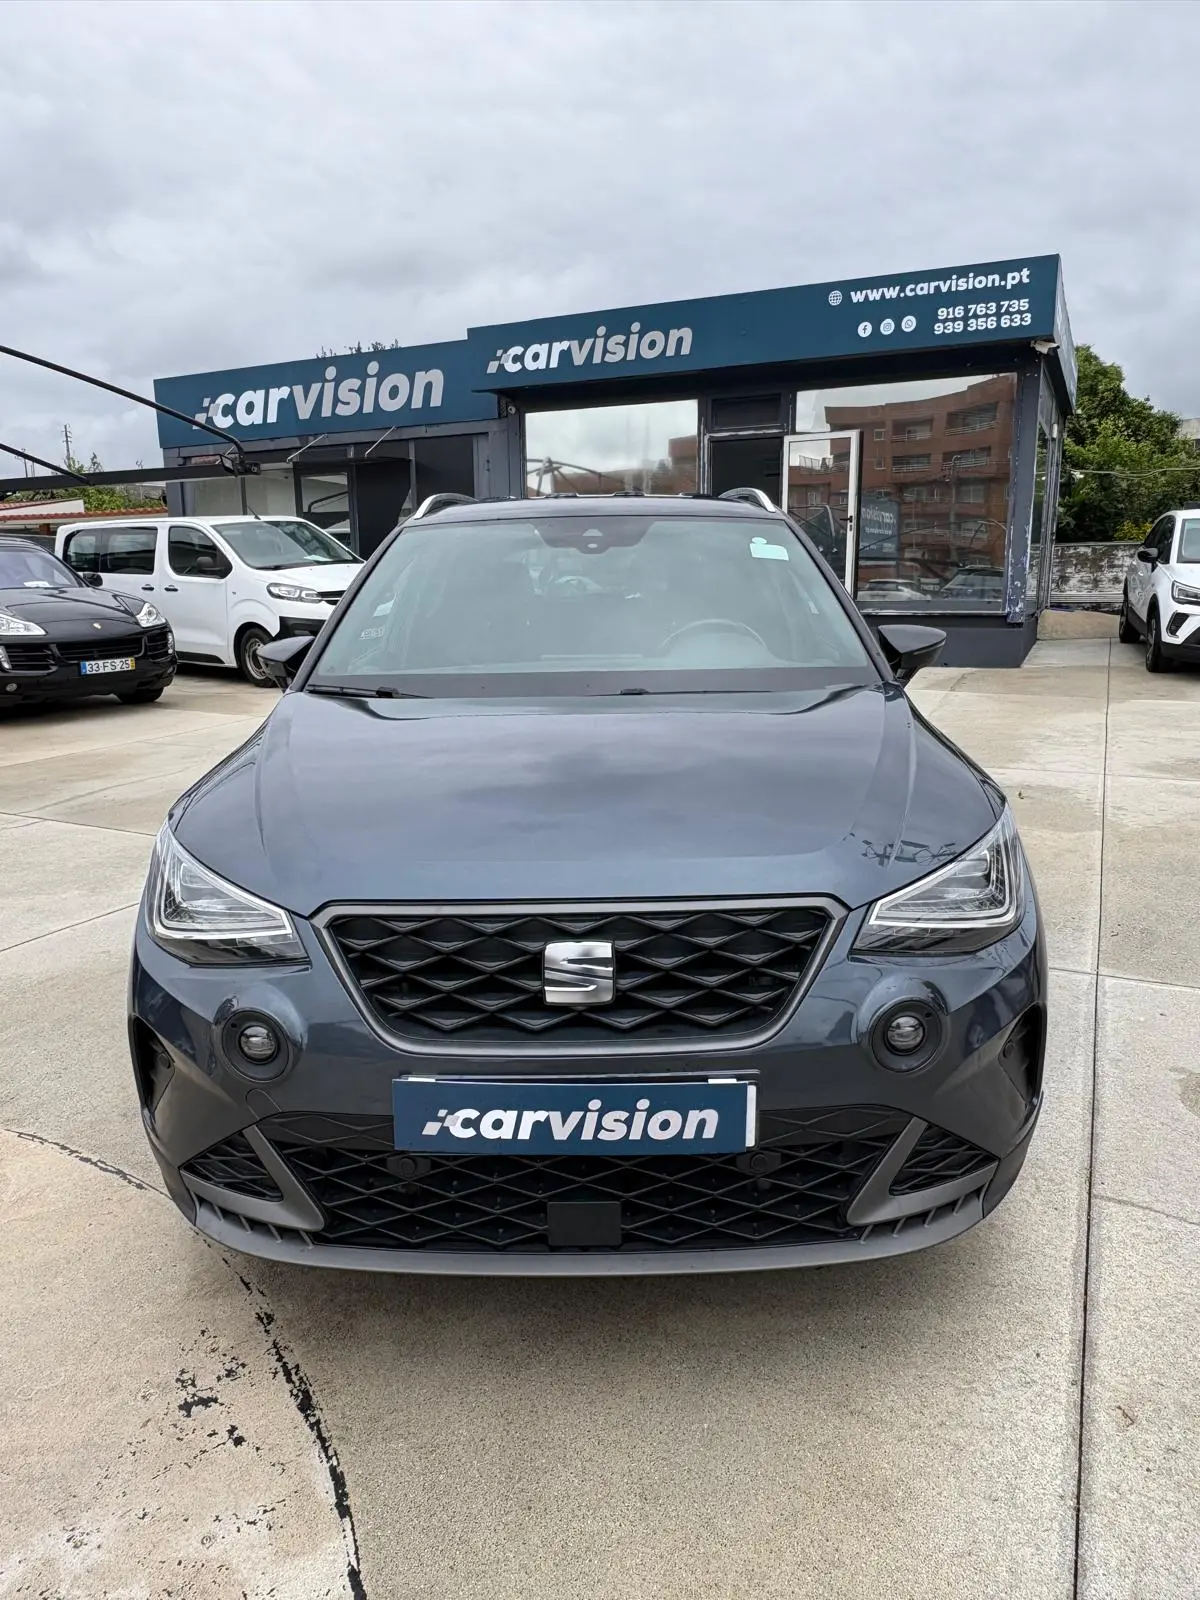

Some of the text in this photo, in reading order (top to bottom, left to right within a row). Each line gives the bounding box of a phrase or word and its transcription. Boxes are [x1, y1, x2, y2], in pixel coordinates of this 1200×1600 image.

[850, 267, 1031, 303] www.carvision.pt
[934, 312, 1032, 335] 939 356 633
[937, 298, 1029, 320] 916 763 735
[502, 322, 693, 373] carvision
[212, 361, 444, 429] carvision
[449, 1098, 719, 1141] carvision
